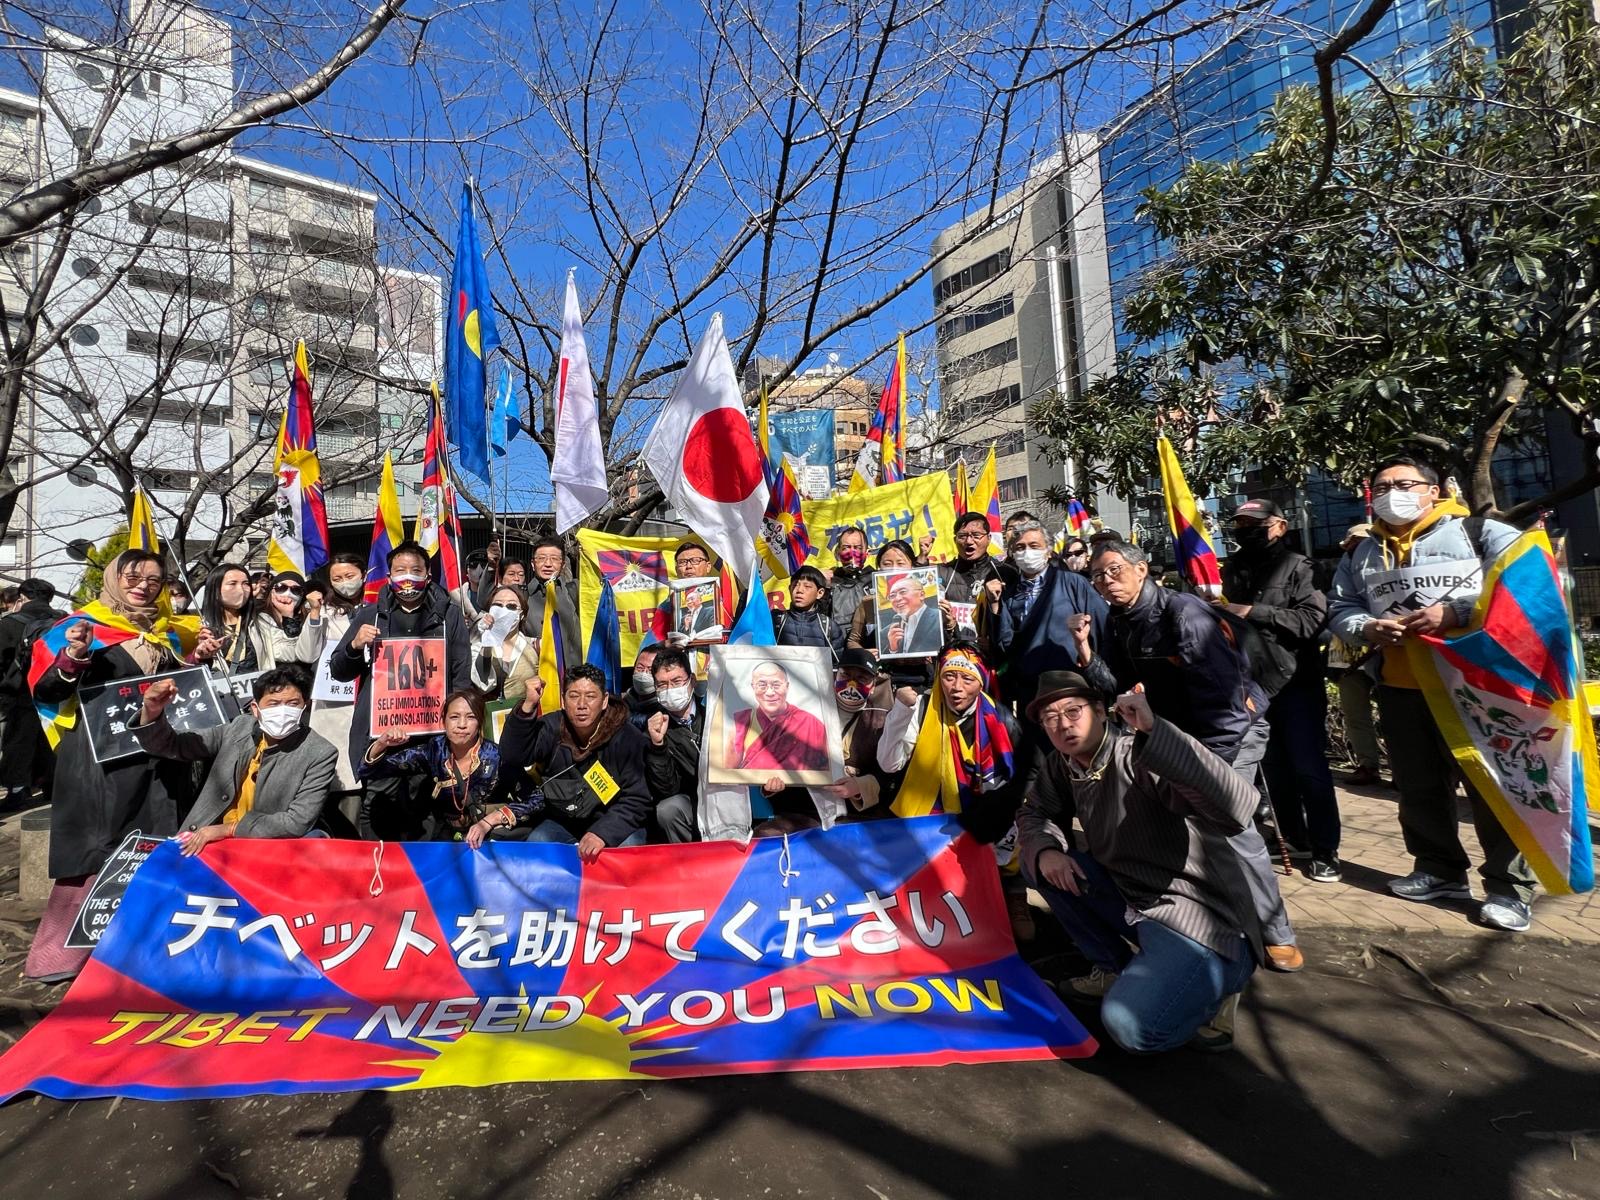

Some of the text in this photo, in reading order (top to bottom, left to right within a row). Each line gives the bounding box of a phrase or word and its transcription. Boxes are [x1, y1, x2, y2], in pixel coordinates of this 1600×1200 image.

[780, 415, 817, 426] 平和と公正を
[781, 424, 817, 435] すべての人に
[1414, 575, 1478, 591] RIVERS:
[382, 644, 438, 691] 160+
[377, 695, 441, 711] SELF IMMOLATIONS
[378, 711, 439, 727] NO CONSOLATIONS
[589, 770, 609, 794] STAFF
[89, 898, 111, 910] THE
[167, 890, 974, 972] チベットを助けてください
[91, 977, 1005, 1048] TIBET NEED YOU NOW
